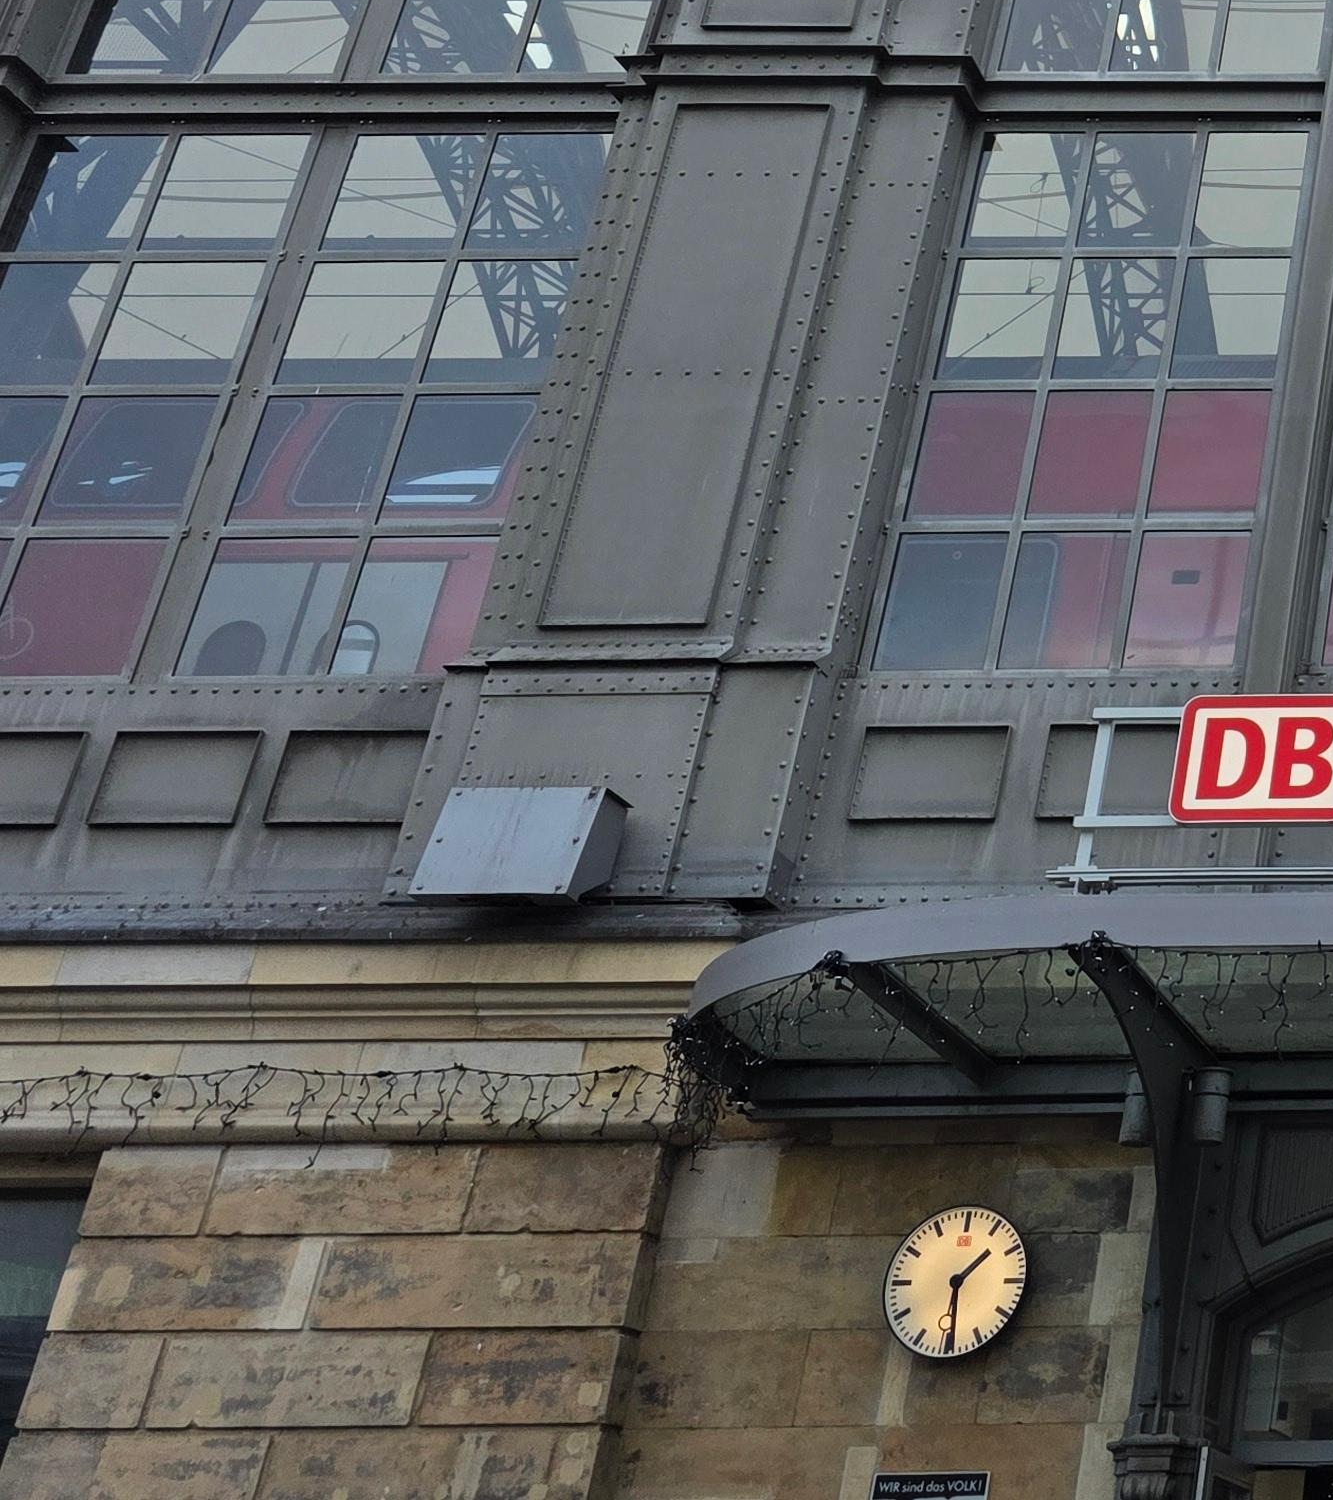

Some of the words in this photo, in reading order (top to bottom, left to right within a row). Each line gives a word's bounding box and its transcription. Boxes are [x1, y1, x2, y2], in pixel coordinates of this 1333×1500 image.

[880, 1481, 900, 1493] WIR
[902, 1480, 924, 1493] sind
[925, 1480, 945, 1493] das
